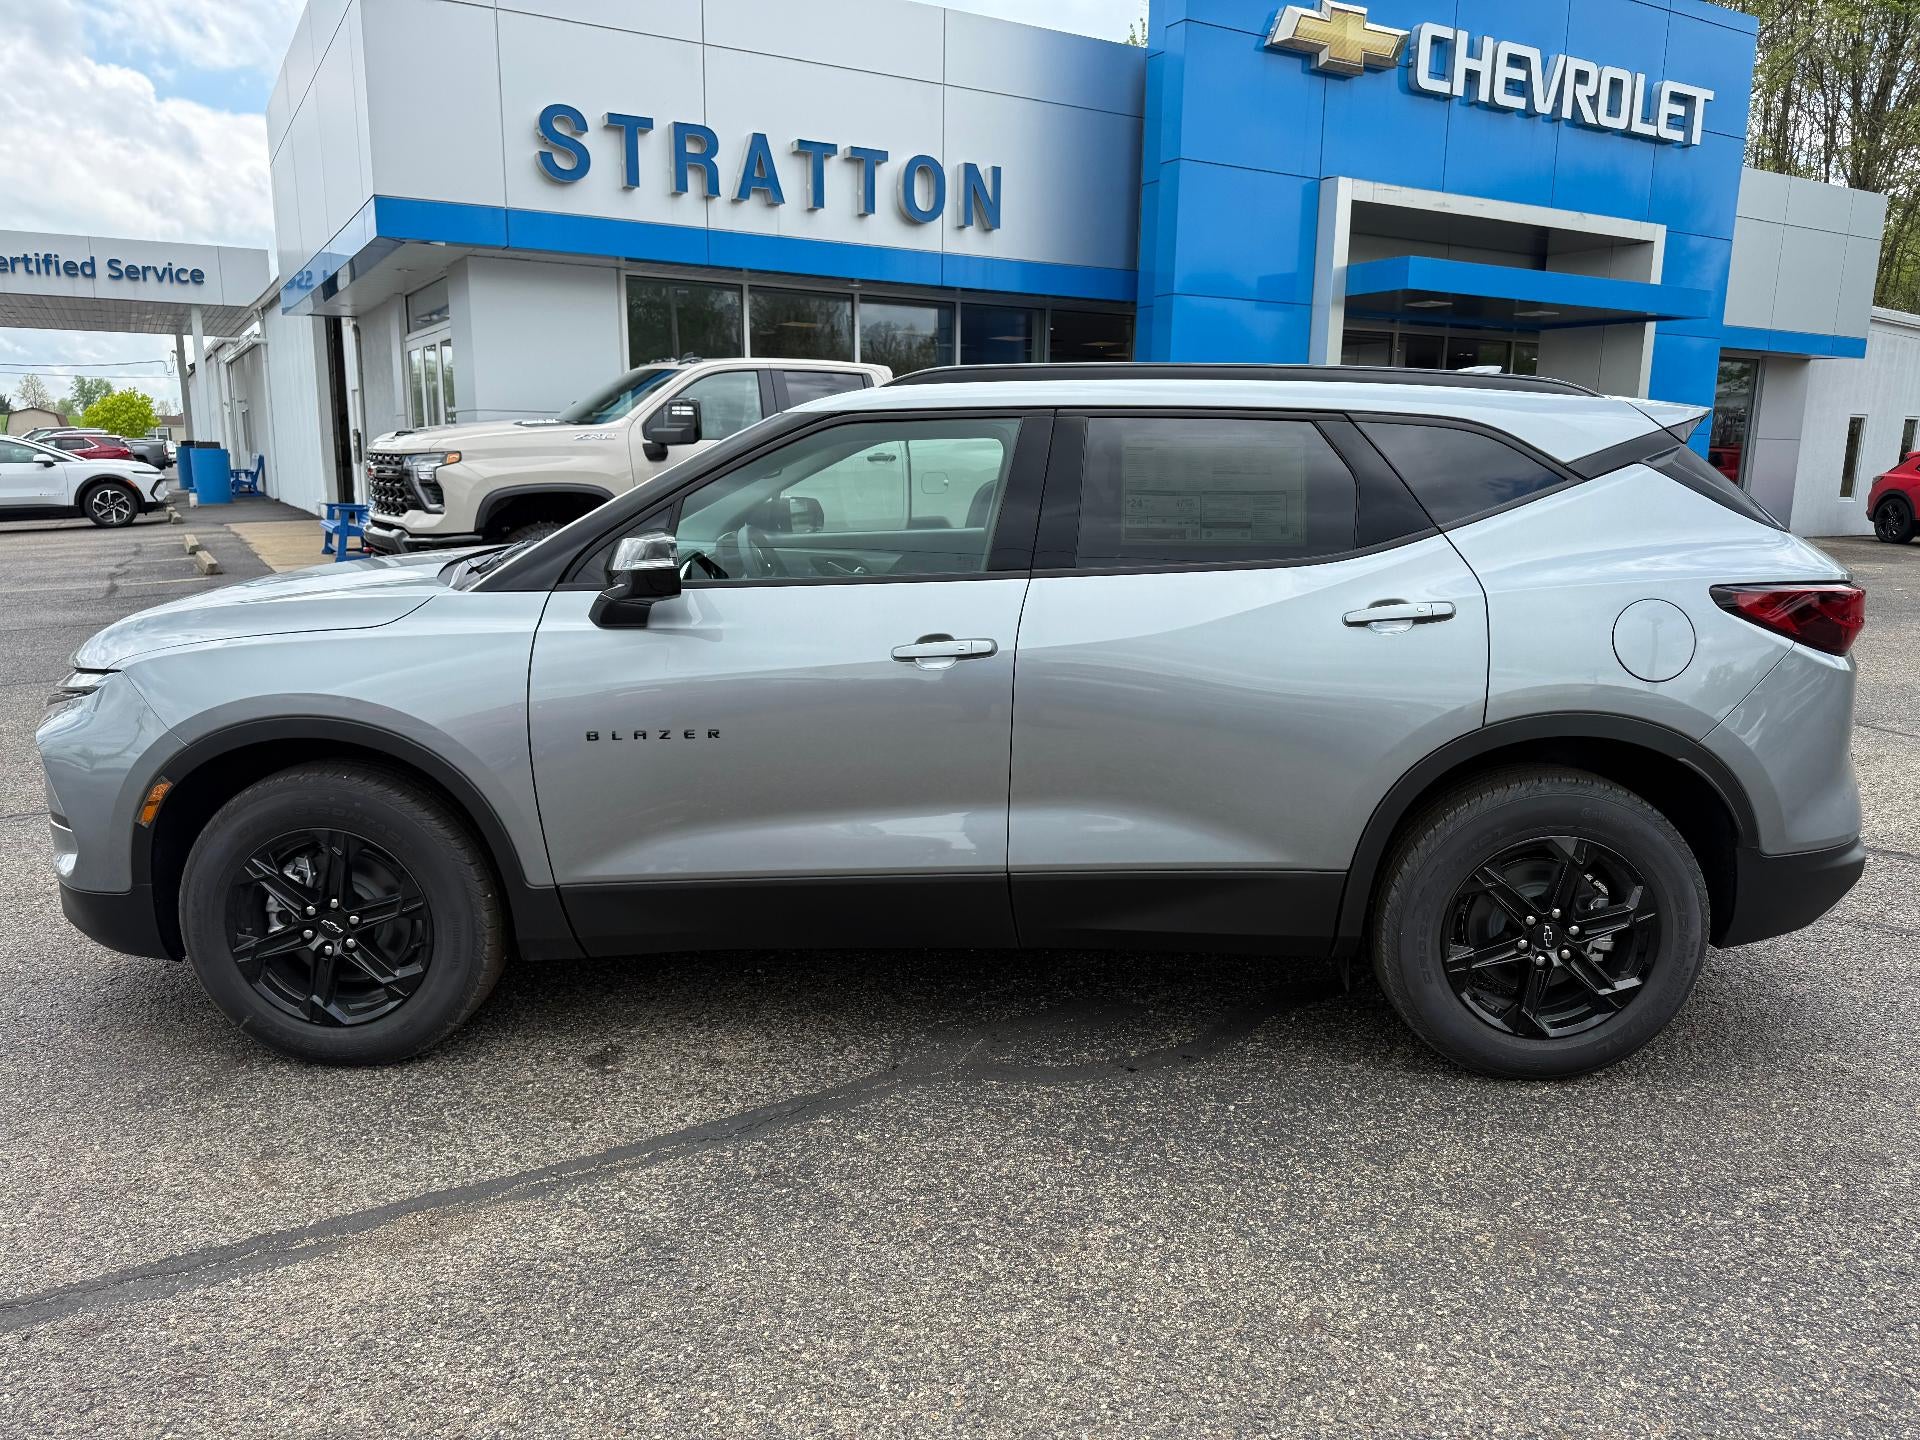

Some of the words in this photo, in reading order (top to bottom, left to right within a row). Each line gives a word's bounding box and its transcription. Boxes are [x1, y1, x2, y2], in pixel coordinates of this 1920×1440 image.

[1409, 21, 1714, 147] CHEVROLET
[535, 103, 1002, 231] STRATTON
[107, 257, 205, 285] Service
[586, 728, 721, 742] BLAZER
